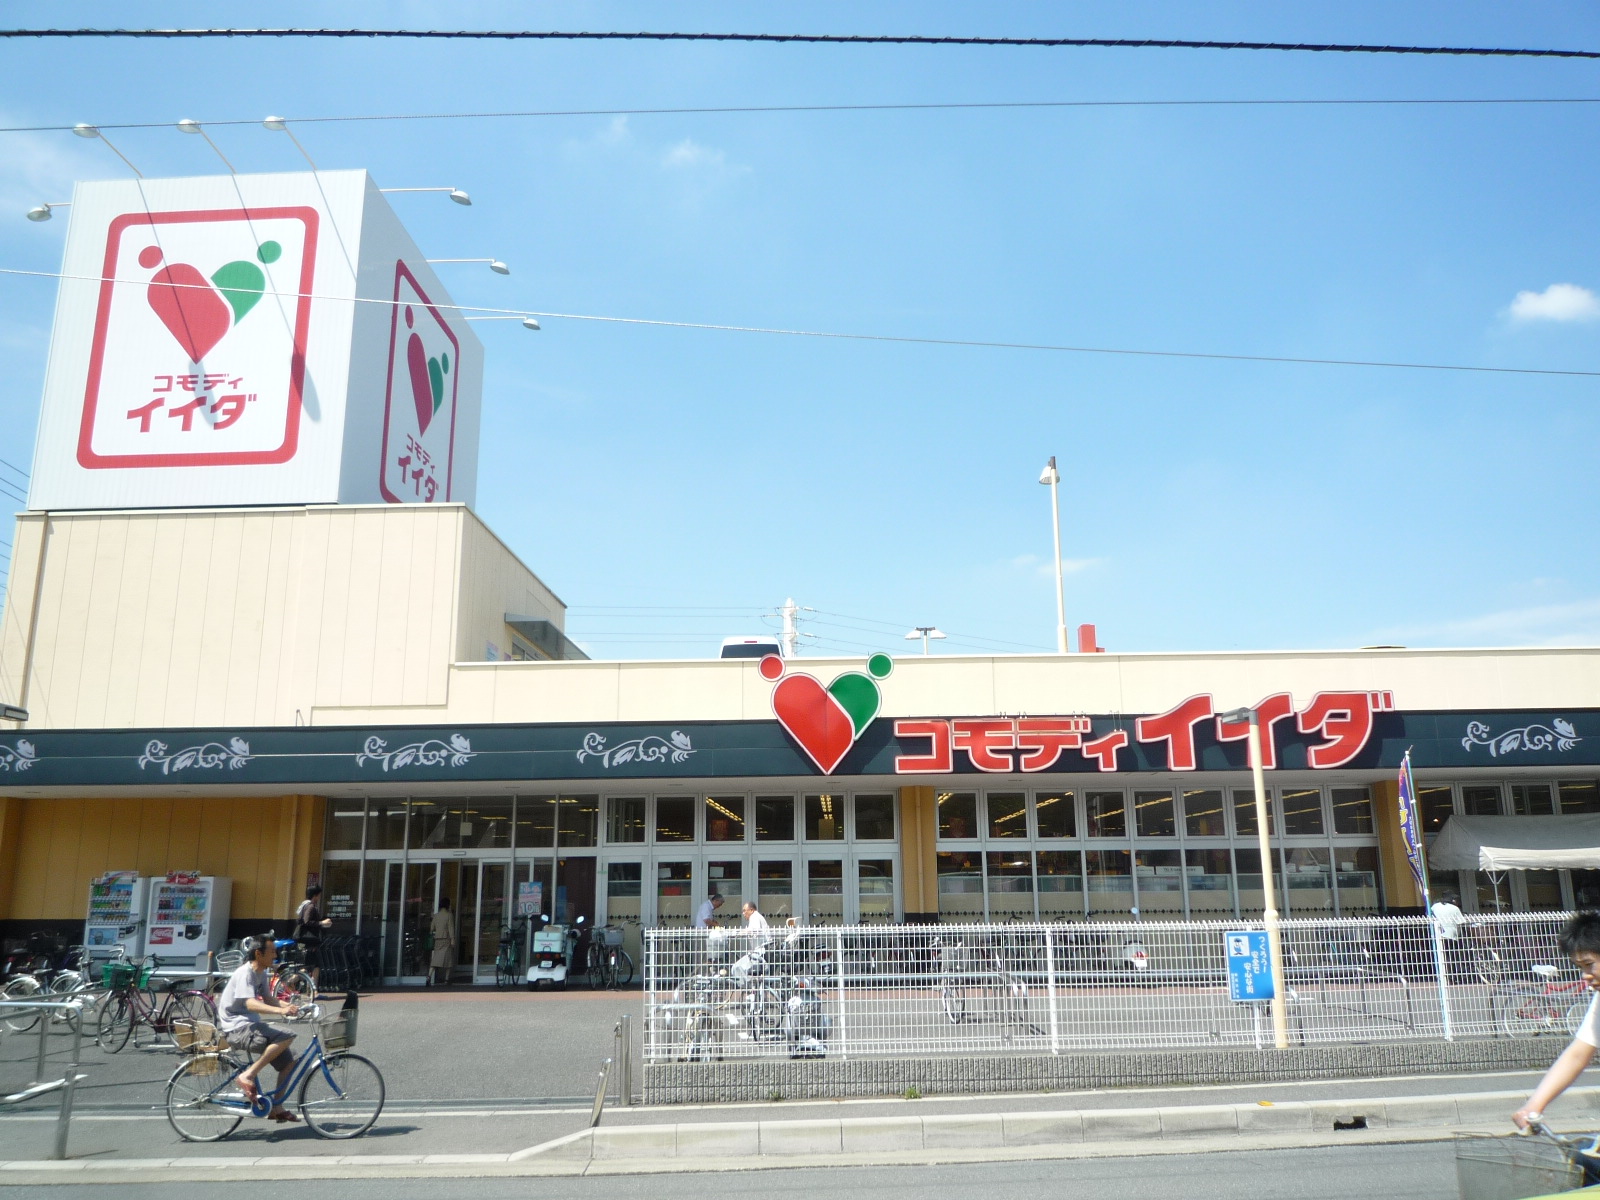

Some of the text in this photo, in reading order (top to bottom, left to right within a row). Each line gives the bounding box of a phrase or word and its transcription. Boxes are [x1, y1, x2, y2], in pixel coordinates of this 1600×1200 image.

[153, 373, 243, 392] コモディ
[127, 394, 257, 433] イイダ
[406, 433, 435, 474] コモディ
[398, 455, 439, 502] イイダ
